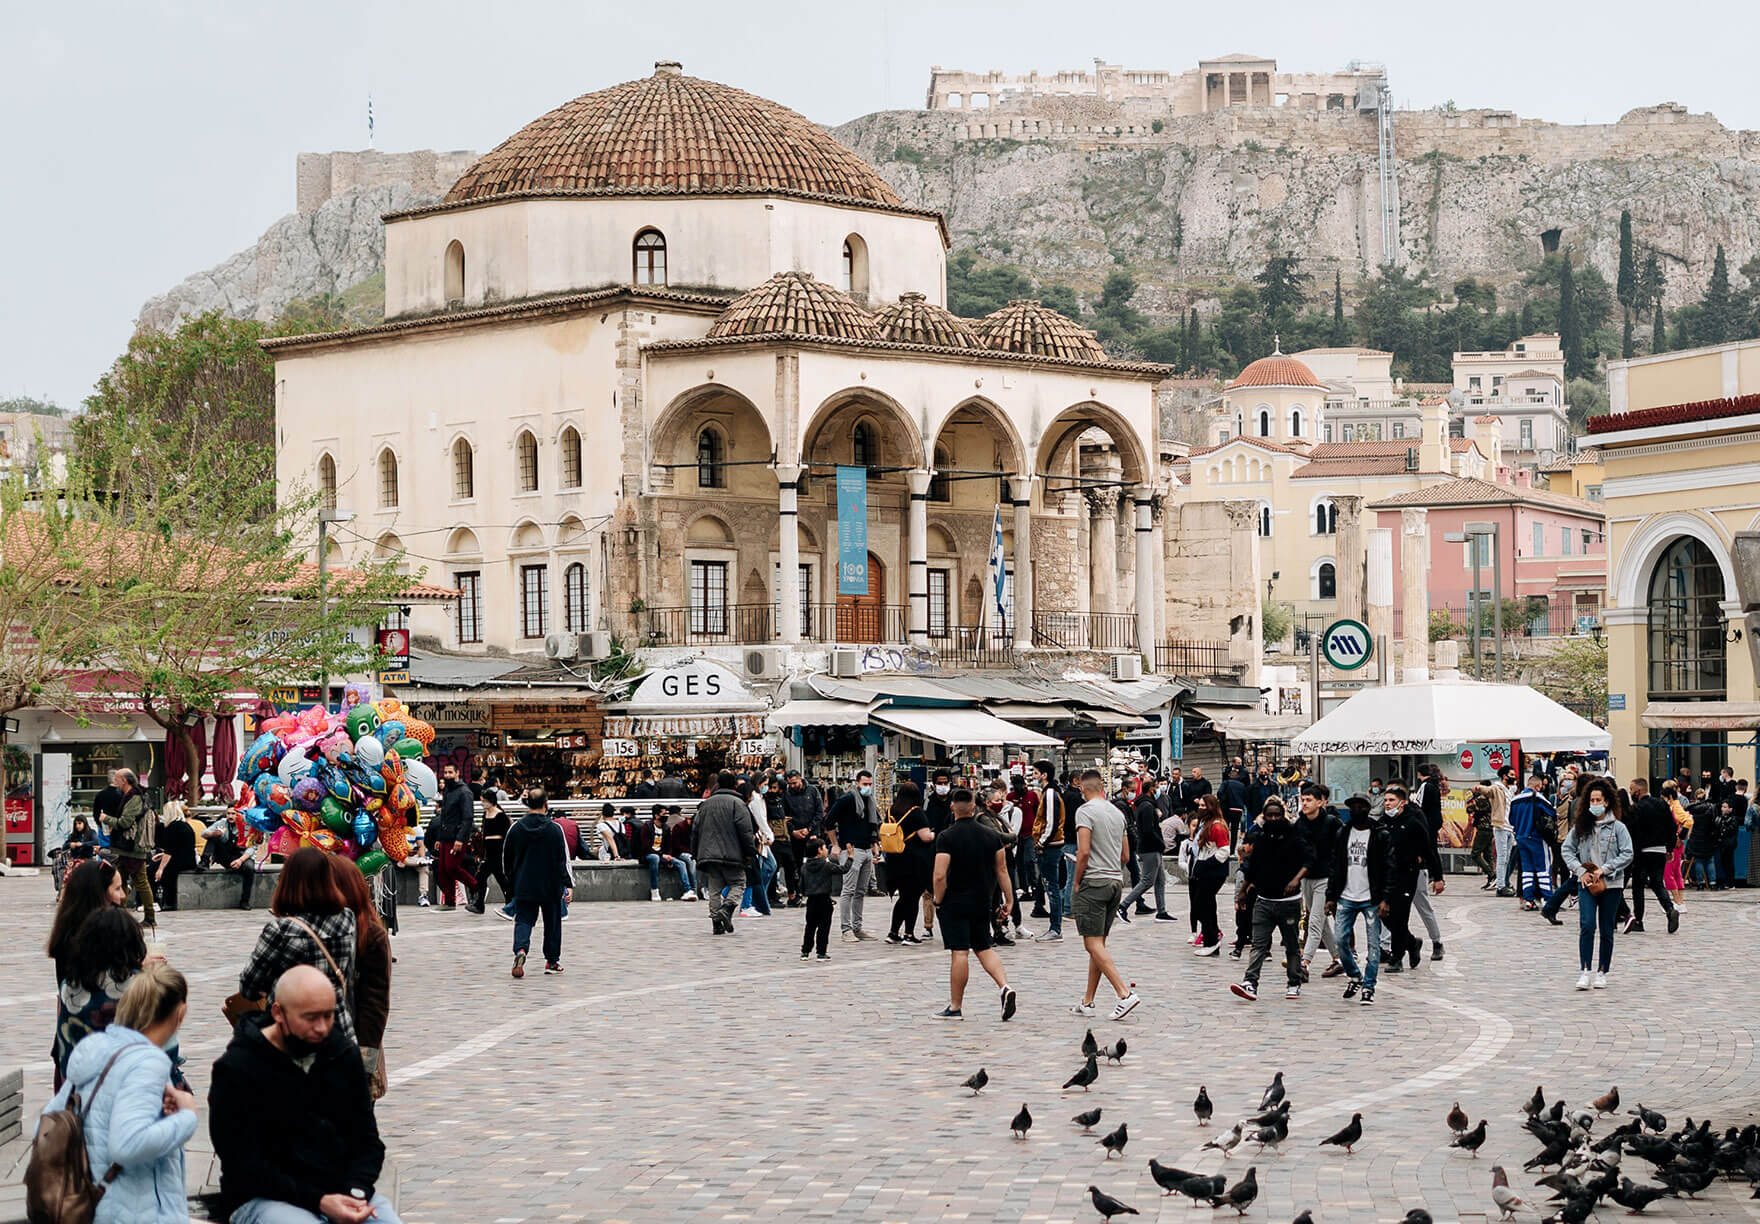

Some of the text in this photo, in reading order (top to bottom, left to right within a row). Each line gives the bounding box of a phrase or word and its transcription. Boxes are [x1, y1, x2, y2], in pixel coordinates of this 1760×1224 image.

[383, 673, 407, 681] ATM
[661, 674, 721, 696] GES
[272, 689, 296, 700] ATM
[424, 708, 440, 721] old
[444, 709, 484, 723] mosque
[556, 736, 584, 749] 15 €
[615, 741, 635, 754] 15€
[745, 741, 763, 753] 15€
[1440, 799, 1466, 809] EMONI
